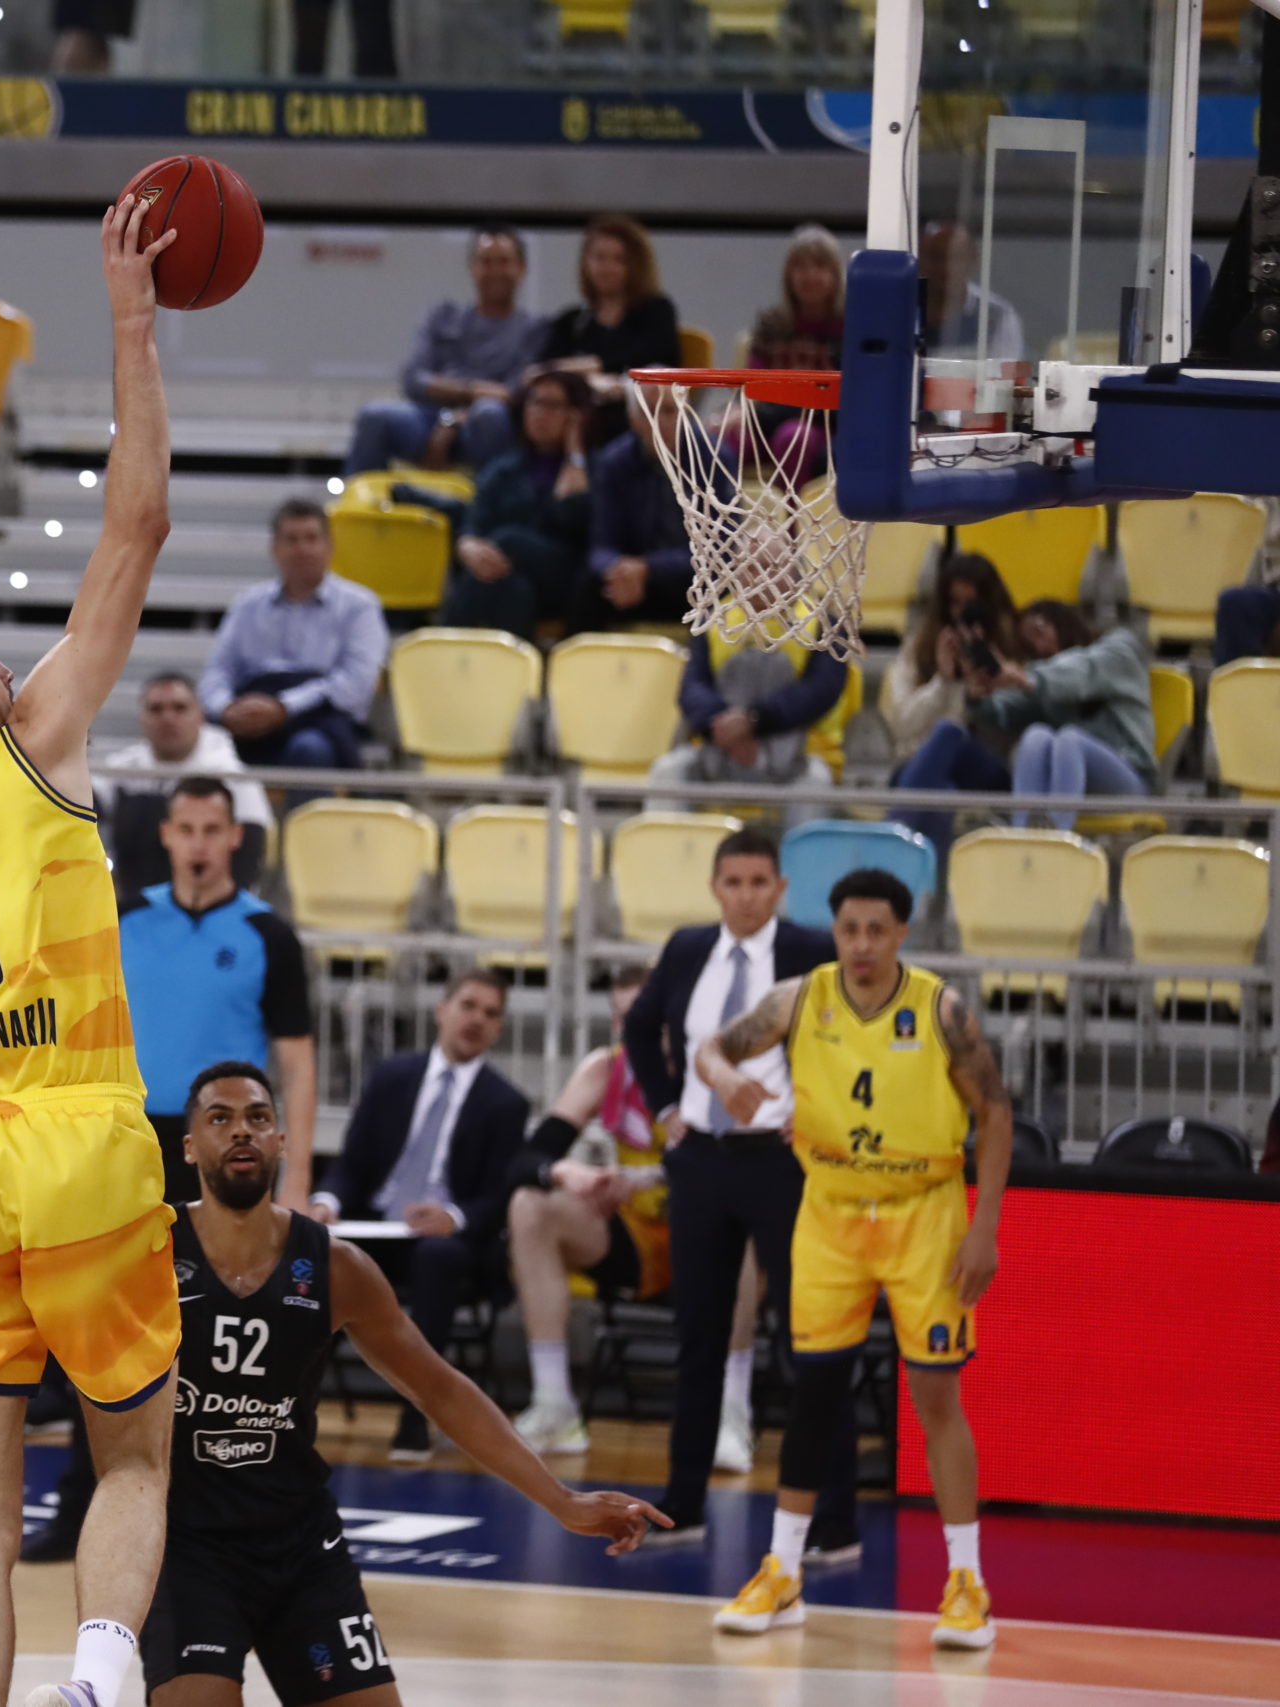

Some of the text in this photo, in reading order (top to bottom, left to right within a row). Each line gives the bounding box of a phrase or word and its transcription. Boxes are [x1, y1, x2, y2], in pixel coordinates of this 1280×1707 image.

[186, 91, 427, 137] GRAN CANARIA
[851, 1068, 873, 1109] 4
[210, 1315, 270, 1376] 52
